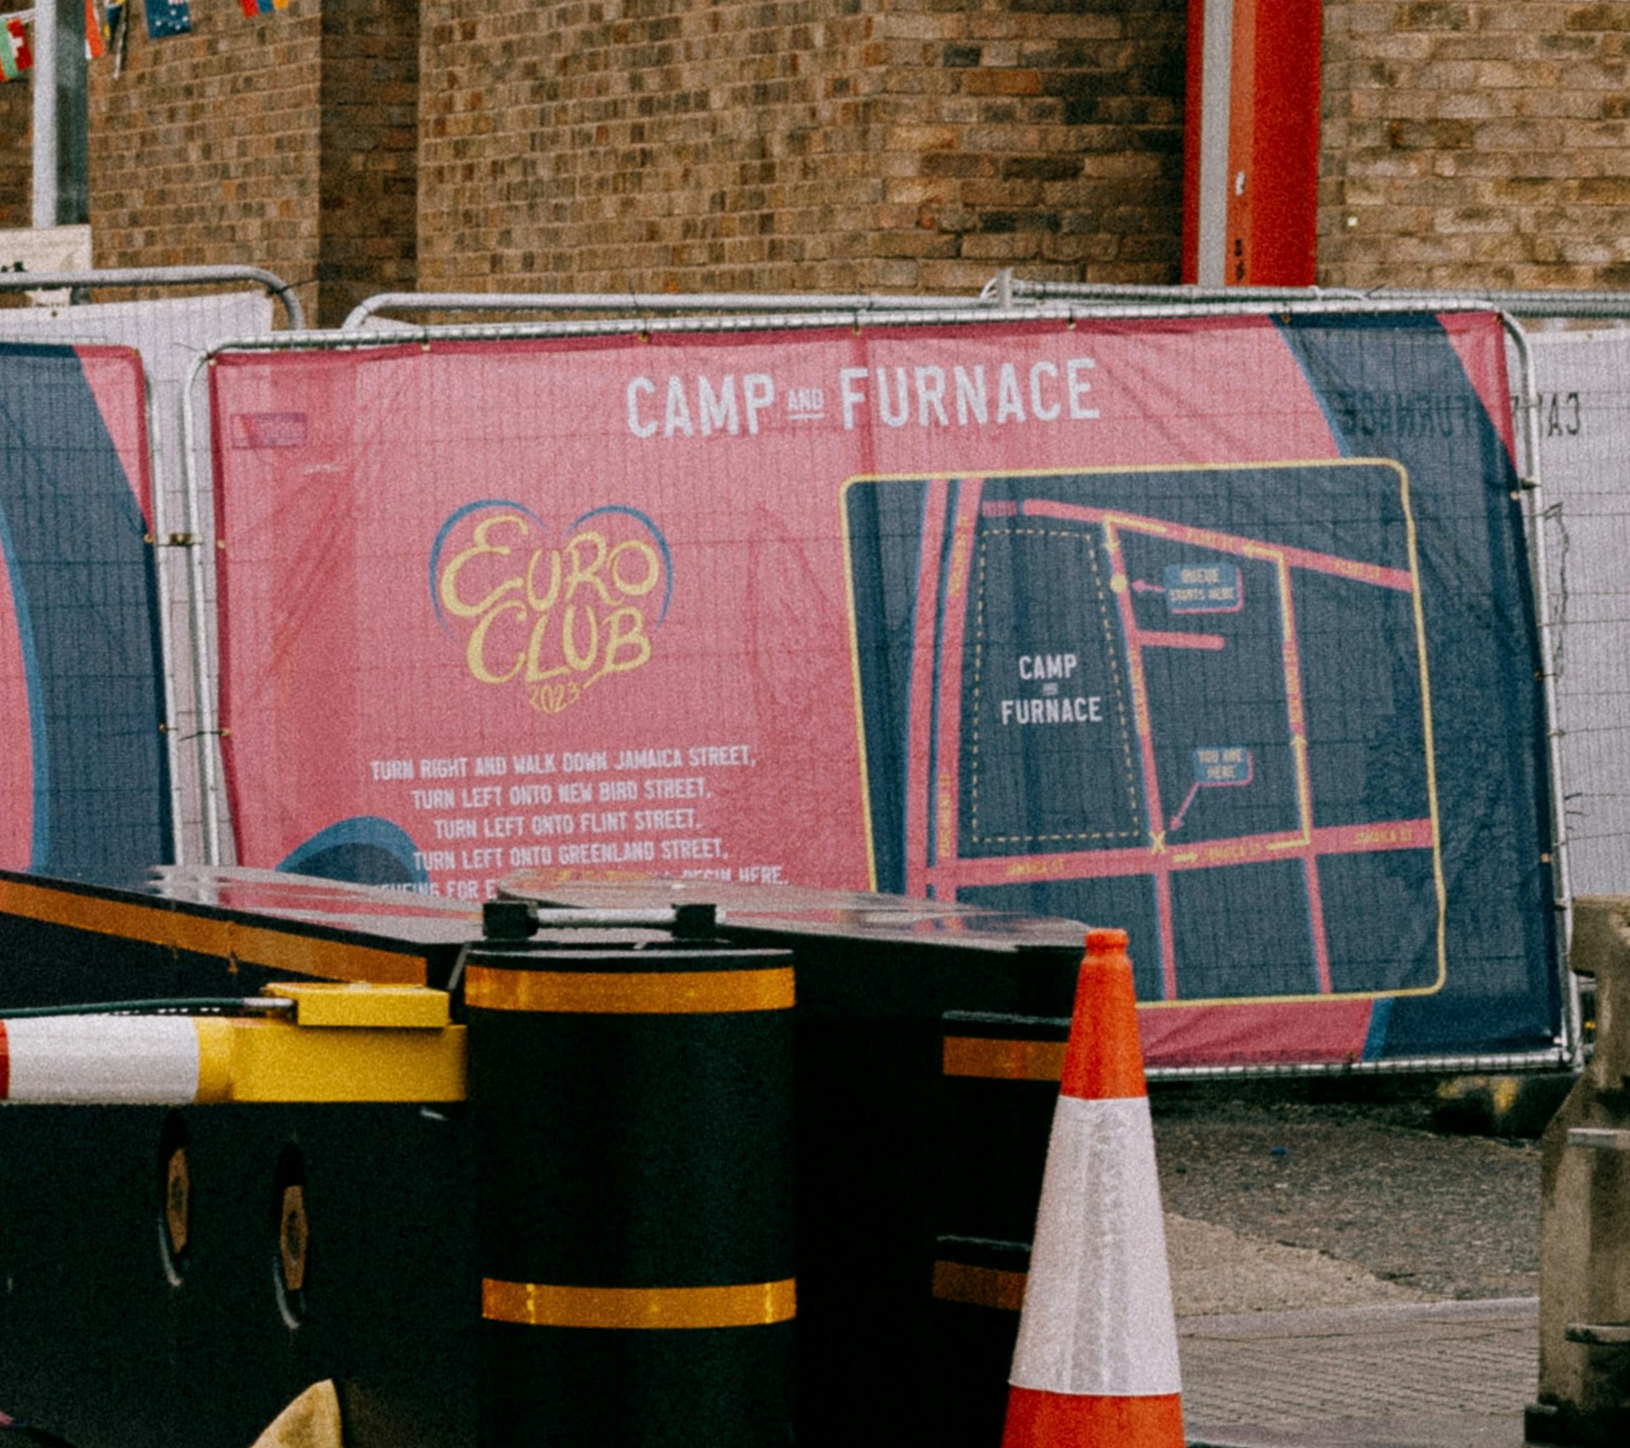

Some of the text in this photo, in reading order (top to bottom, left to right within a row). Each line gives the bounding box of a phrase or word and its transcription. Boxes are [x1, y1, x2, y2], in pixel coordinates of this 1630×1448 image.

[626, 358, 1101, 439] CAMP AND FURNACE
[440, 514, 659, 617] EURO
[466, 599, 653, 689] CLUB
[1018, 653, 1078, 680] CAMP
[528, 681, 581, 715] 2023
[1001, 696, 1103, 726] FURNACE
[370, 759, 414, 782] TURN
[420, 757, 468, 779] RIGHT
[475, 755, 507, 776] AND
[512, 752, 557, 775] WALK
[562, 751, 608, 773] DOWN
[615, 748, 684, 770] JAMAICA
[412, 789, 455, 810] TURN
[462, 787, 502, 808] LEFT
[510, 785, 552, 806] ONTO
[558, 782, 593, 803] NEW
[599, 780, 638, 801] BIRD
[434, 818, 477, 840] TURN
[483, 816, 524, 838] LEFT
[531, 814, 574, 835] ONTO
[580, 811, 627, 833] FLINT
[413, 849, 455, 871] TURN
[462, 848, 503, 869] LEFT
[510, 846, 552, 867] ONTO
[558, 840, 655, 865] GREENLAND
